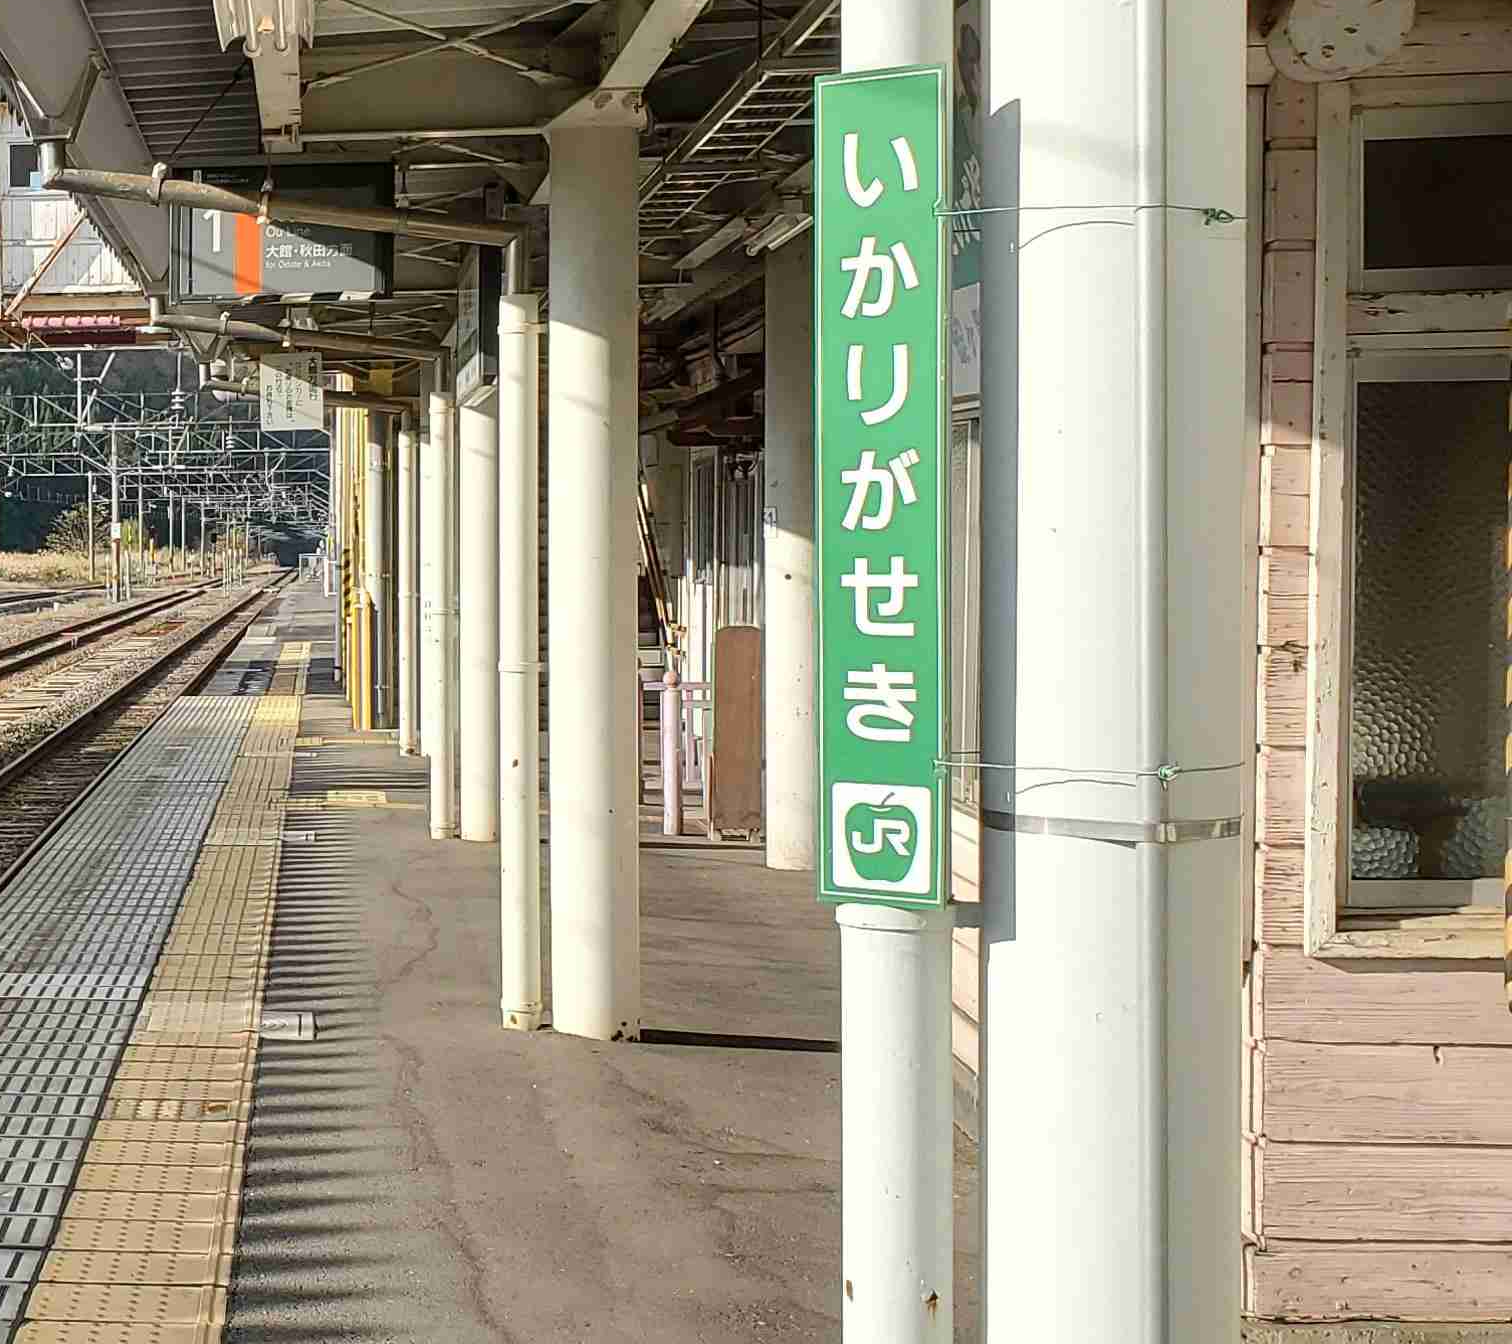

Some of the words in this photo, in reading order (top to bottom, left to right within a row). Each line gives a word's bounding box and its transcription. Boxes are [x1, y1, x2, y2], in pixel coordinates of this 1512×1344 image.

[839, 132, 921, 744] いかりがせき
[851, 818, 911, 857] JR
